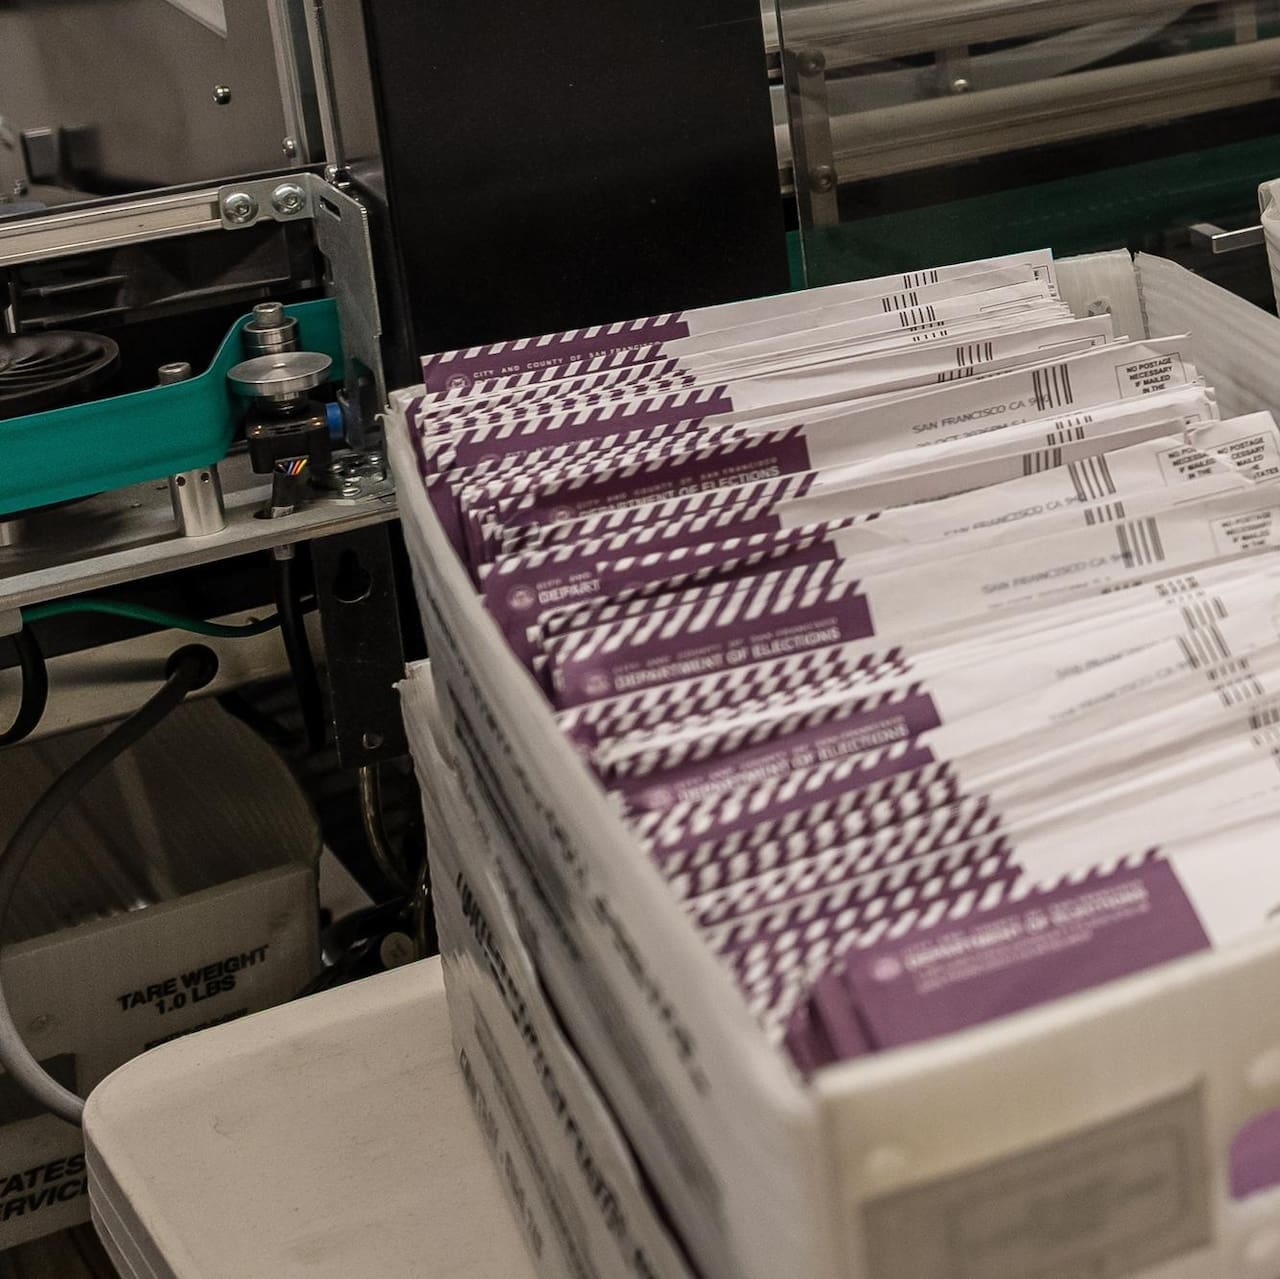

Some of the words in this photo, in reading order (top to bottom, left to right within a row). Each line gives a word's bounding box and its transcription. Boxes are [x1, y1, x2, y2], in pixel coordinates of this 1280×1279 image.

[473, 370, 494, 379] CITY
[502, 365, 520, 374] AND
[527, 358, 563, 369] COUNTY
[1129, 366, 1173, 380] NECESSARY
[1139, 357, 1172, 370] POSTAGE
[1143, 374, 1171, 386] MAILED
[912, 422, 938, 434] SAN
[941, 405, 1007, 428] FRANCISCO
[1009, 401, 1026, 412] CA
[117, 978, 177, 1011] TARE
[180, 944, 269, 991] WEIGHT
[155, 995, 187, 1015] 1.0
[192, 974, 237, 1003] LBS
[0, 1153, 85, 1196] ATES
